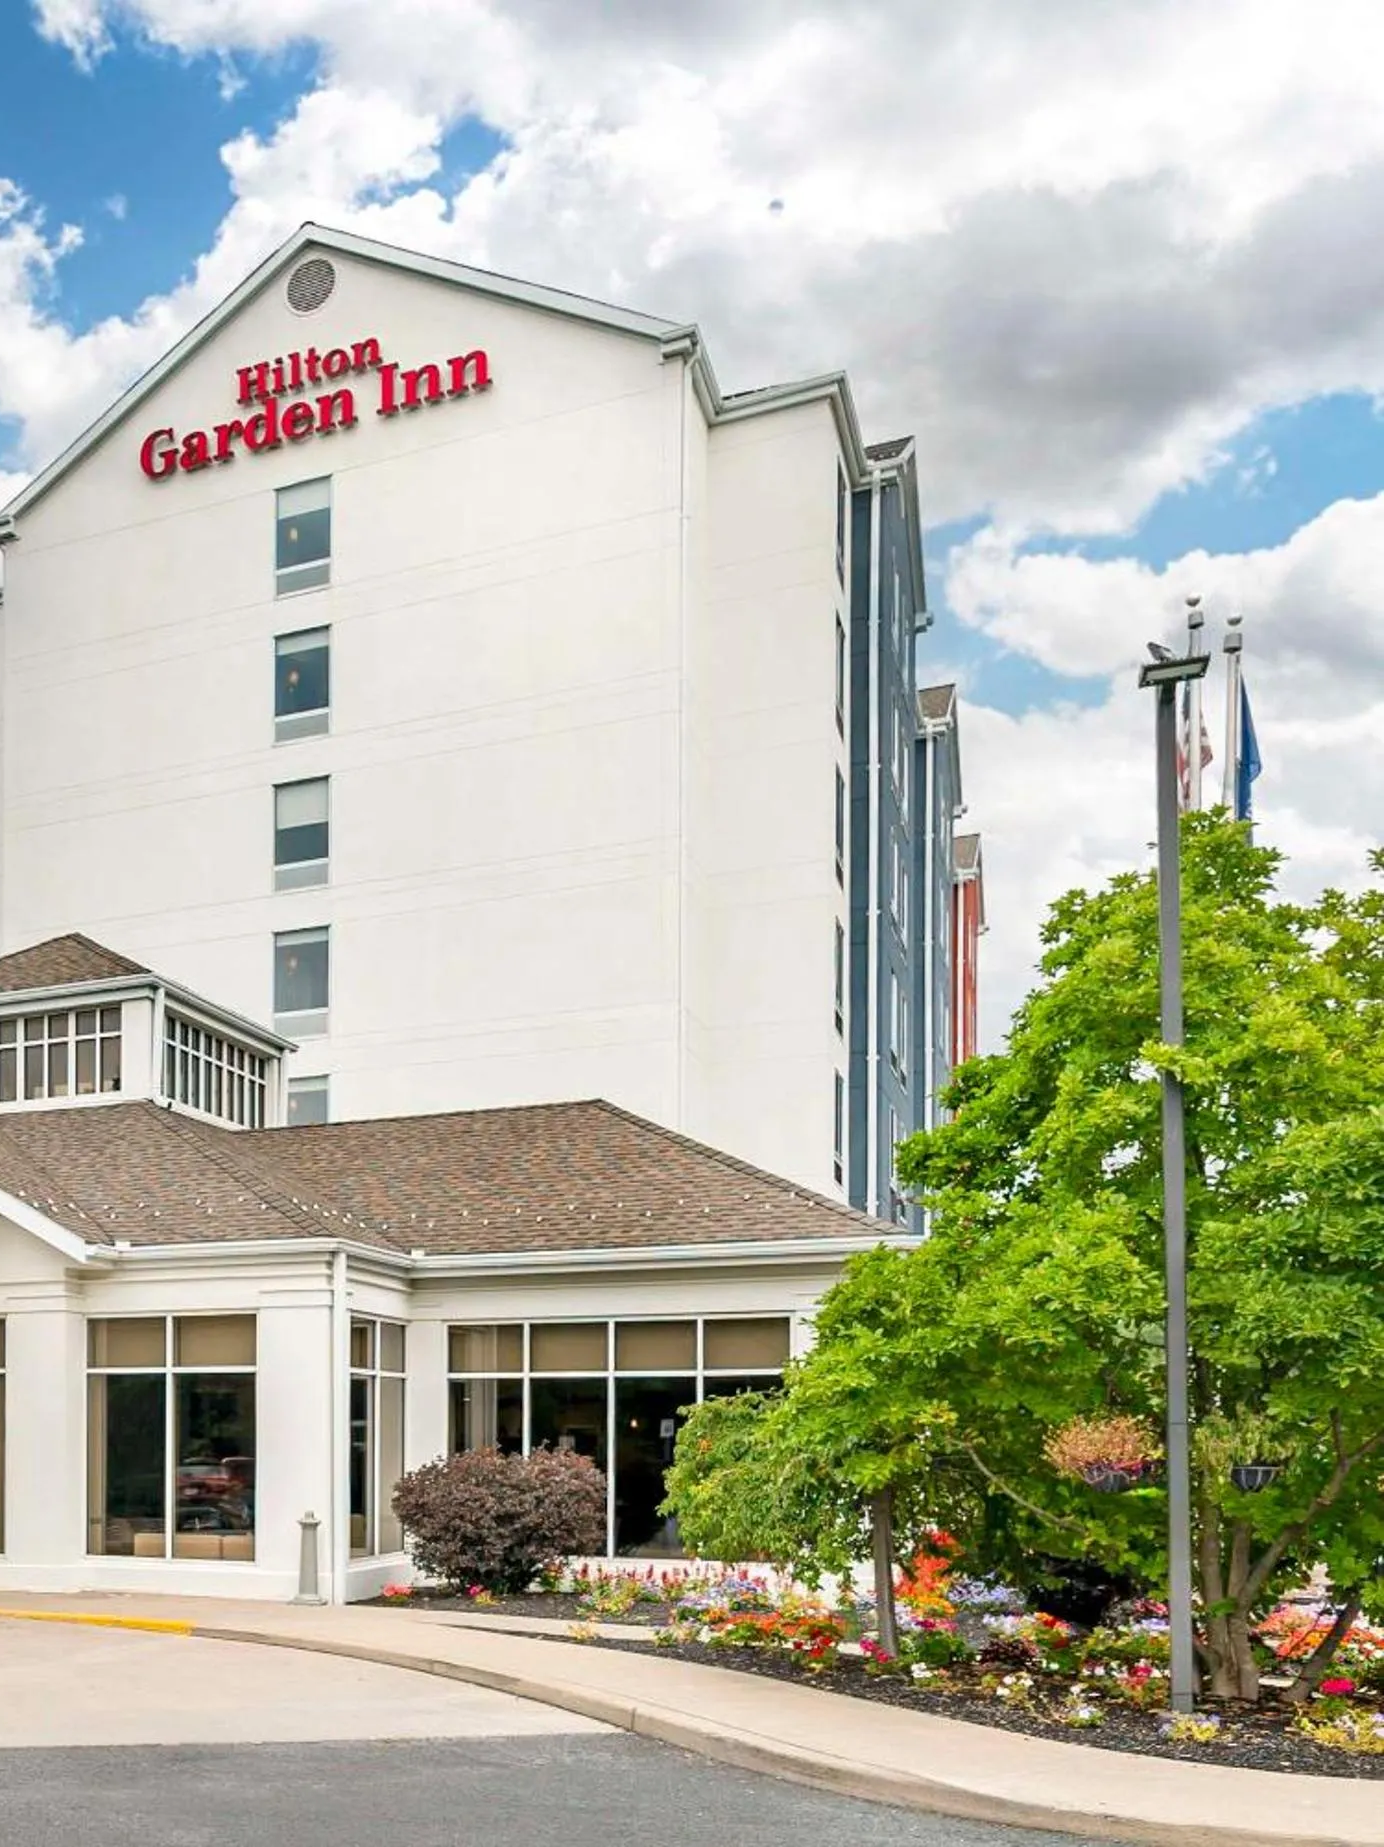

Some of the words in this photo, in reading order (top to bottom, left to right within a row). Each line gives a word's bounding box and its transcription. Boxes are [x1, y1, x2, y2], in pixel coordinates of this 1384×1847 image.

[139, 387, 358, 479] Garden
[376, 348, 493, 417] Inn
[236, 336, 383, 405] Hilton
